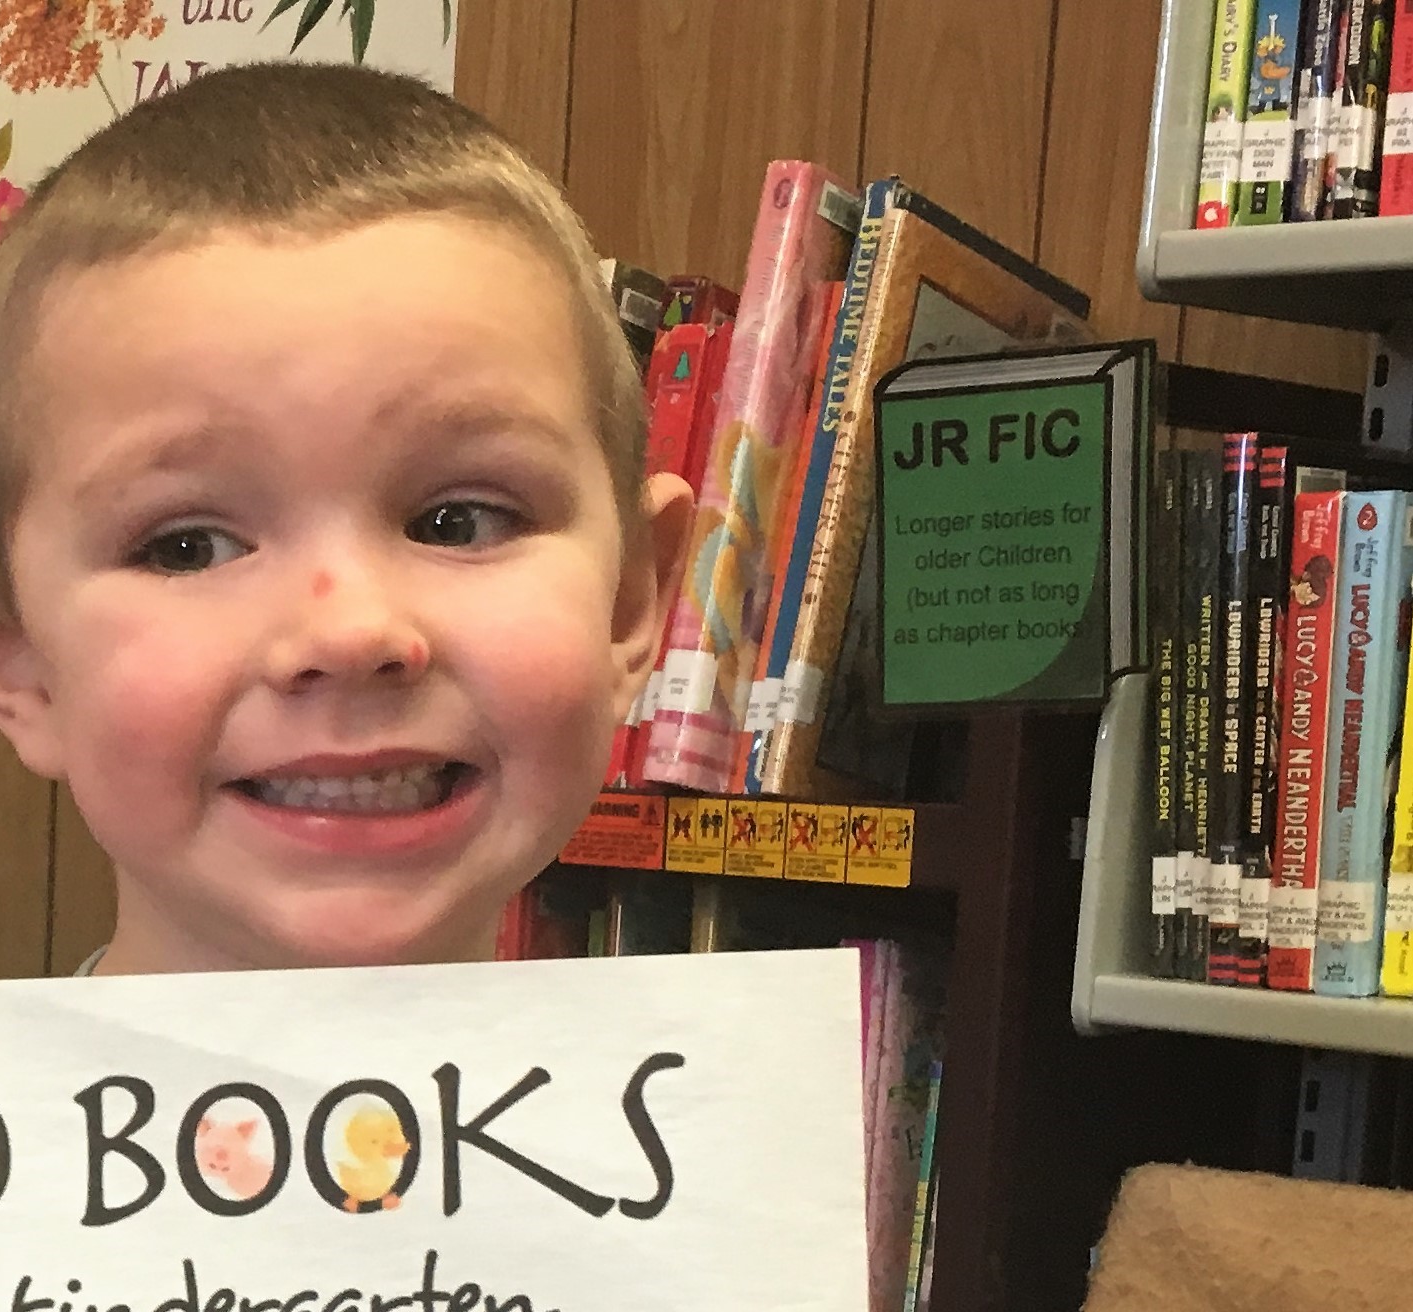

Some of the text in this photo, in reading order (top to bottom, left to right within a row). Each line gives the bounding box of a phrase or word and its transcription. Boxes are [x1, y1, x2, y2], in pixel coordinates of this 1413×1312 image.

[840, 217, 883, 345] BEDTIME
[823, 353, 851, 433] TALES
[893, 408, 1081, 470] JR FIC
[895, 502, 1091, 538] Longer stories for
[915, 542, 1072, 571] older Children
[907, 580, 1080, 612] (but not as long
[1350, 584, 1371, 630] LUCY
[894, 627, 919, 645] as
[927, 621, 1009, 647] chapter
[1161, 639, 1172, 671] THE
[1200, 594, 1212, 667] WRITTEN
[1226, 600, 1242, 699] LOWRIDERS
[1256, 597, 1273, 688] LOWRIDERS
[1295, 615, 1317, 667] LUCY
[1187, 643, 1197, 689] GOOD
[1346, 647, 1367, 696] ANDY
[1160, 707, 1171, 740] WET
[1199, 696, 1210, 752] DRAWN
[1254, 716, 1267, 765] CENTER
[1291, 688, 1312, 741] ANDY
[1224, 718, 1239, 774] SPACE
[1337, 699, 1365, 813] NEANDERTHAL
[1159, 745, 1171, 820] BALLOON
[1184, 751, 1194, 813] PLANET
[1250, 793, 1263, 834] EARTH
[74, 1052, 685, 1227] BOOKS
